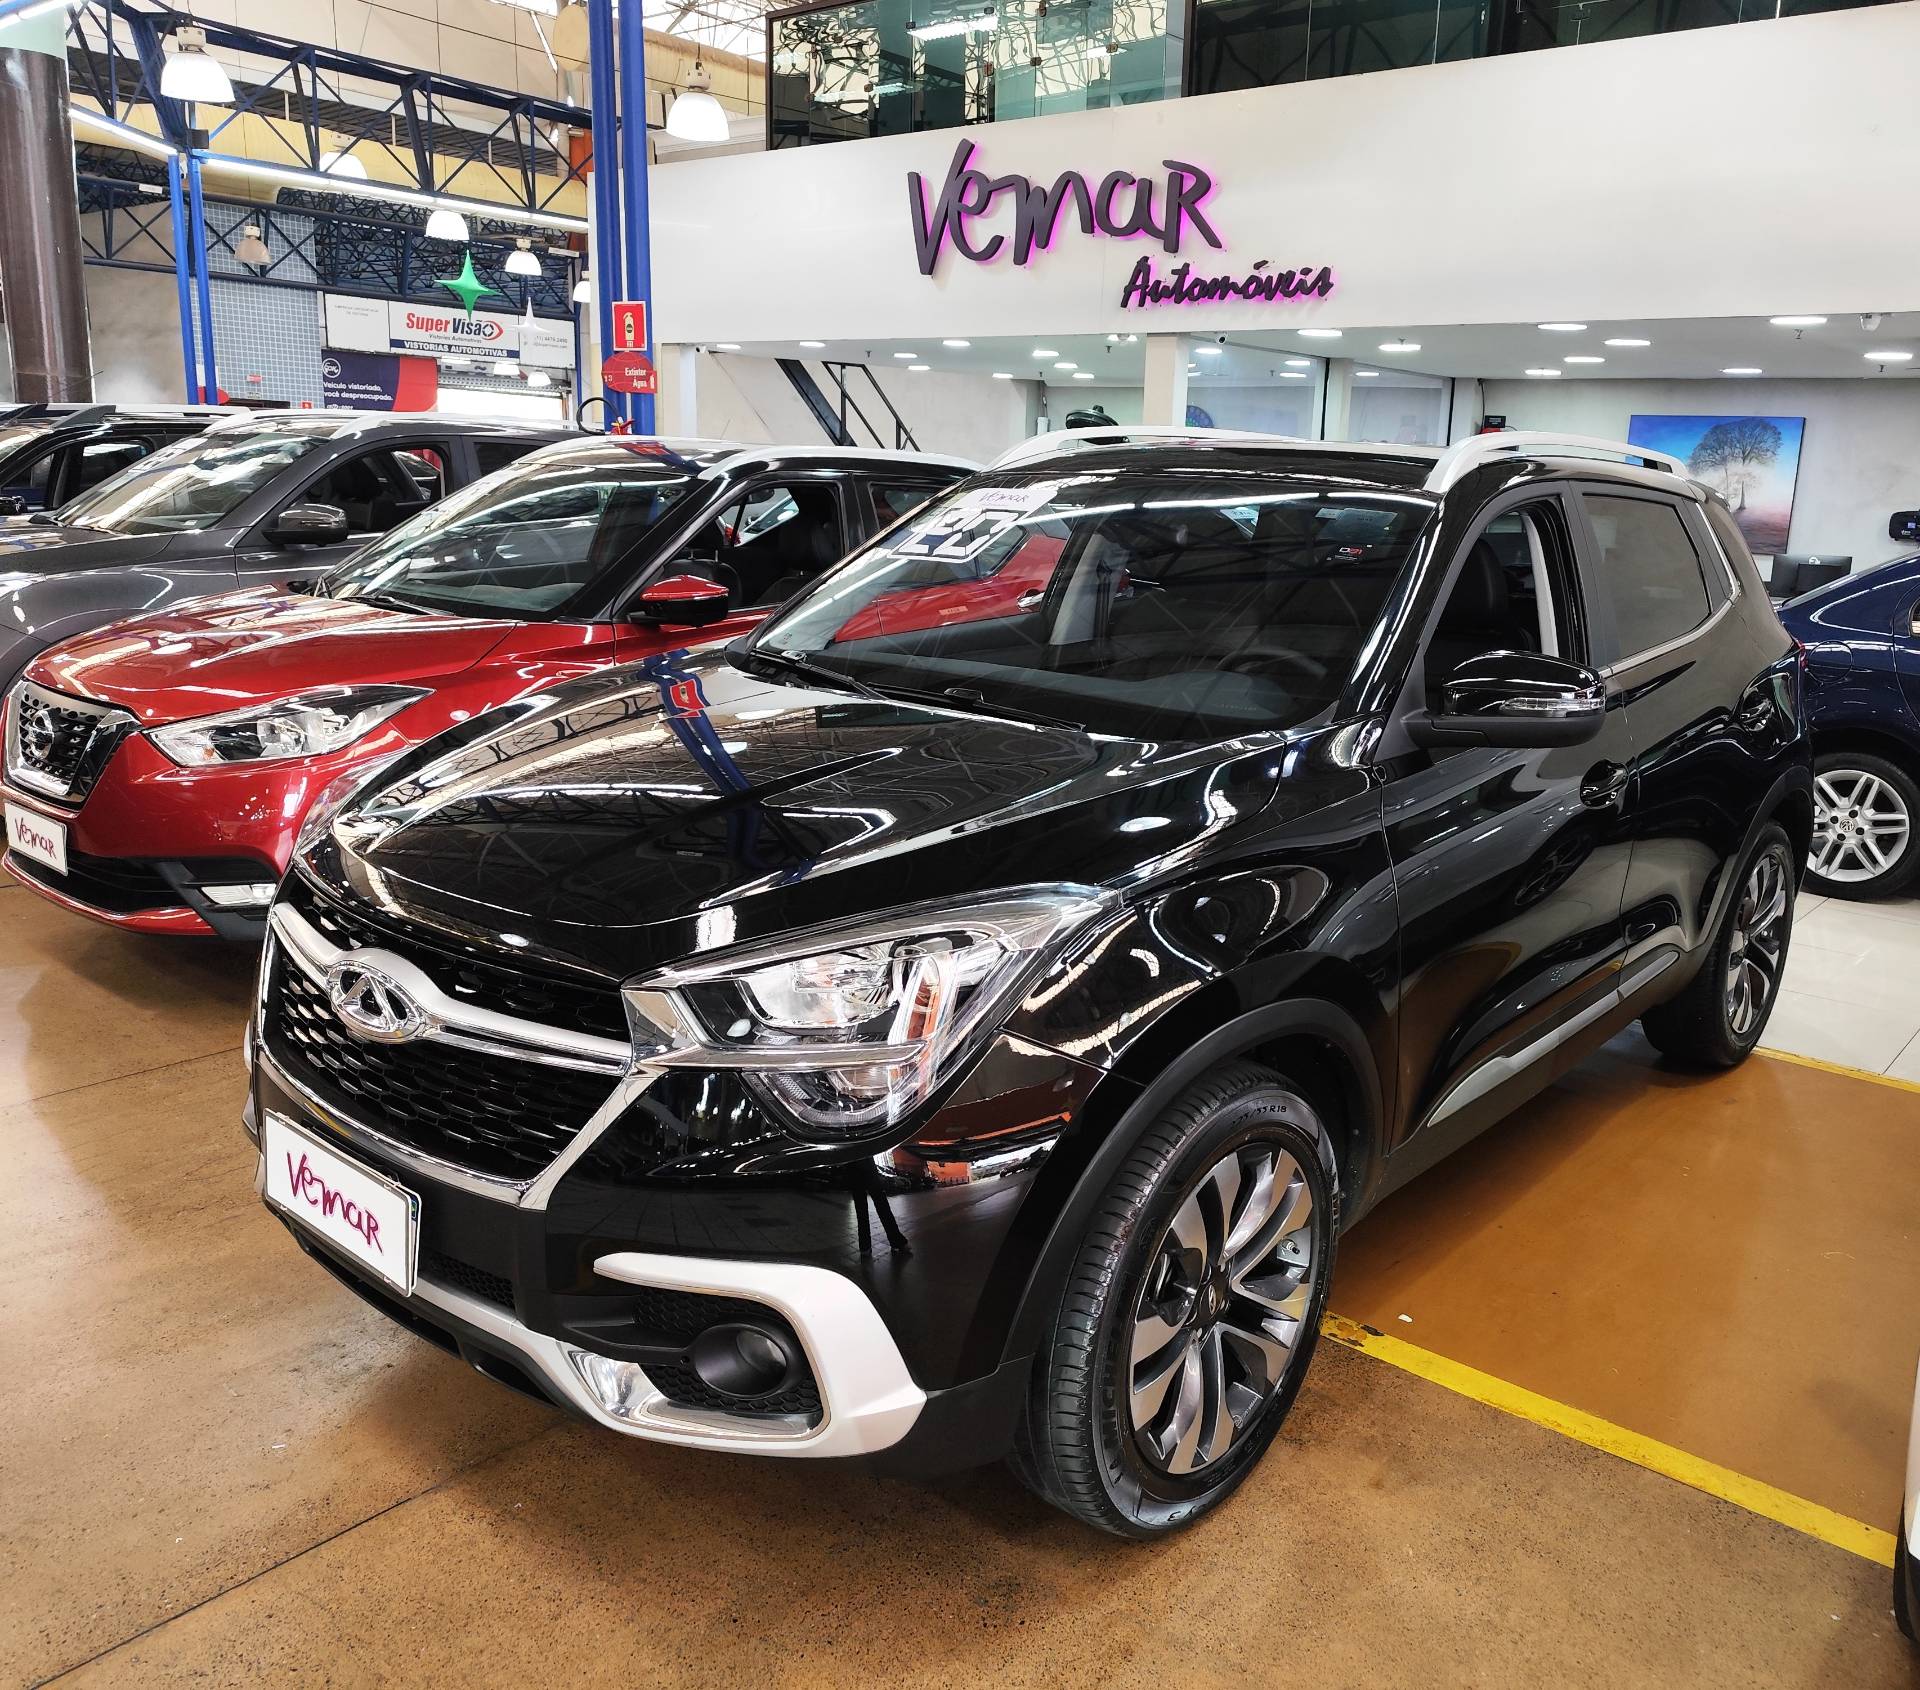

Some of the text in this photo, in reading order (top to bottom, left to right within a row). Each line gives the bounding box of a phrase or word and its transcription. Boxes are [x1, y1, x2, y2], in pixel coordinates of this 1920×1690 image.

[1119, 254, 1335, 309] Automóveis
[406, 312, 450, 333] Super
[404, 340, 508, 357] VISTORIAS AUTOMOTIVAS
[624, 367, 647, 377] Extintor
[633, 376, 648, 388] Água
[897, 508, 1019, 557] 20
